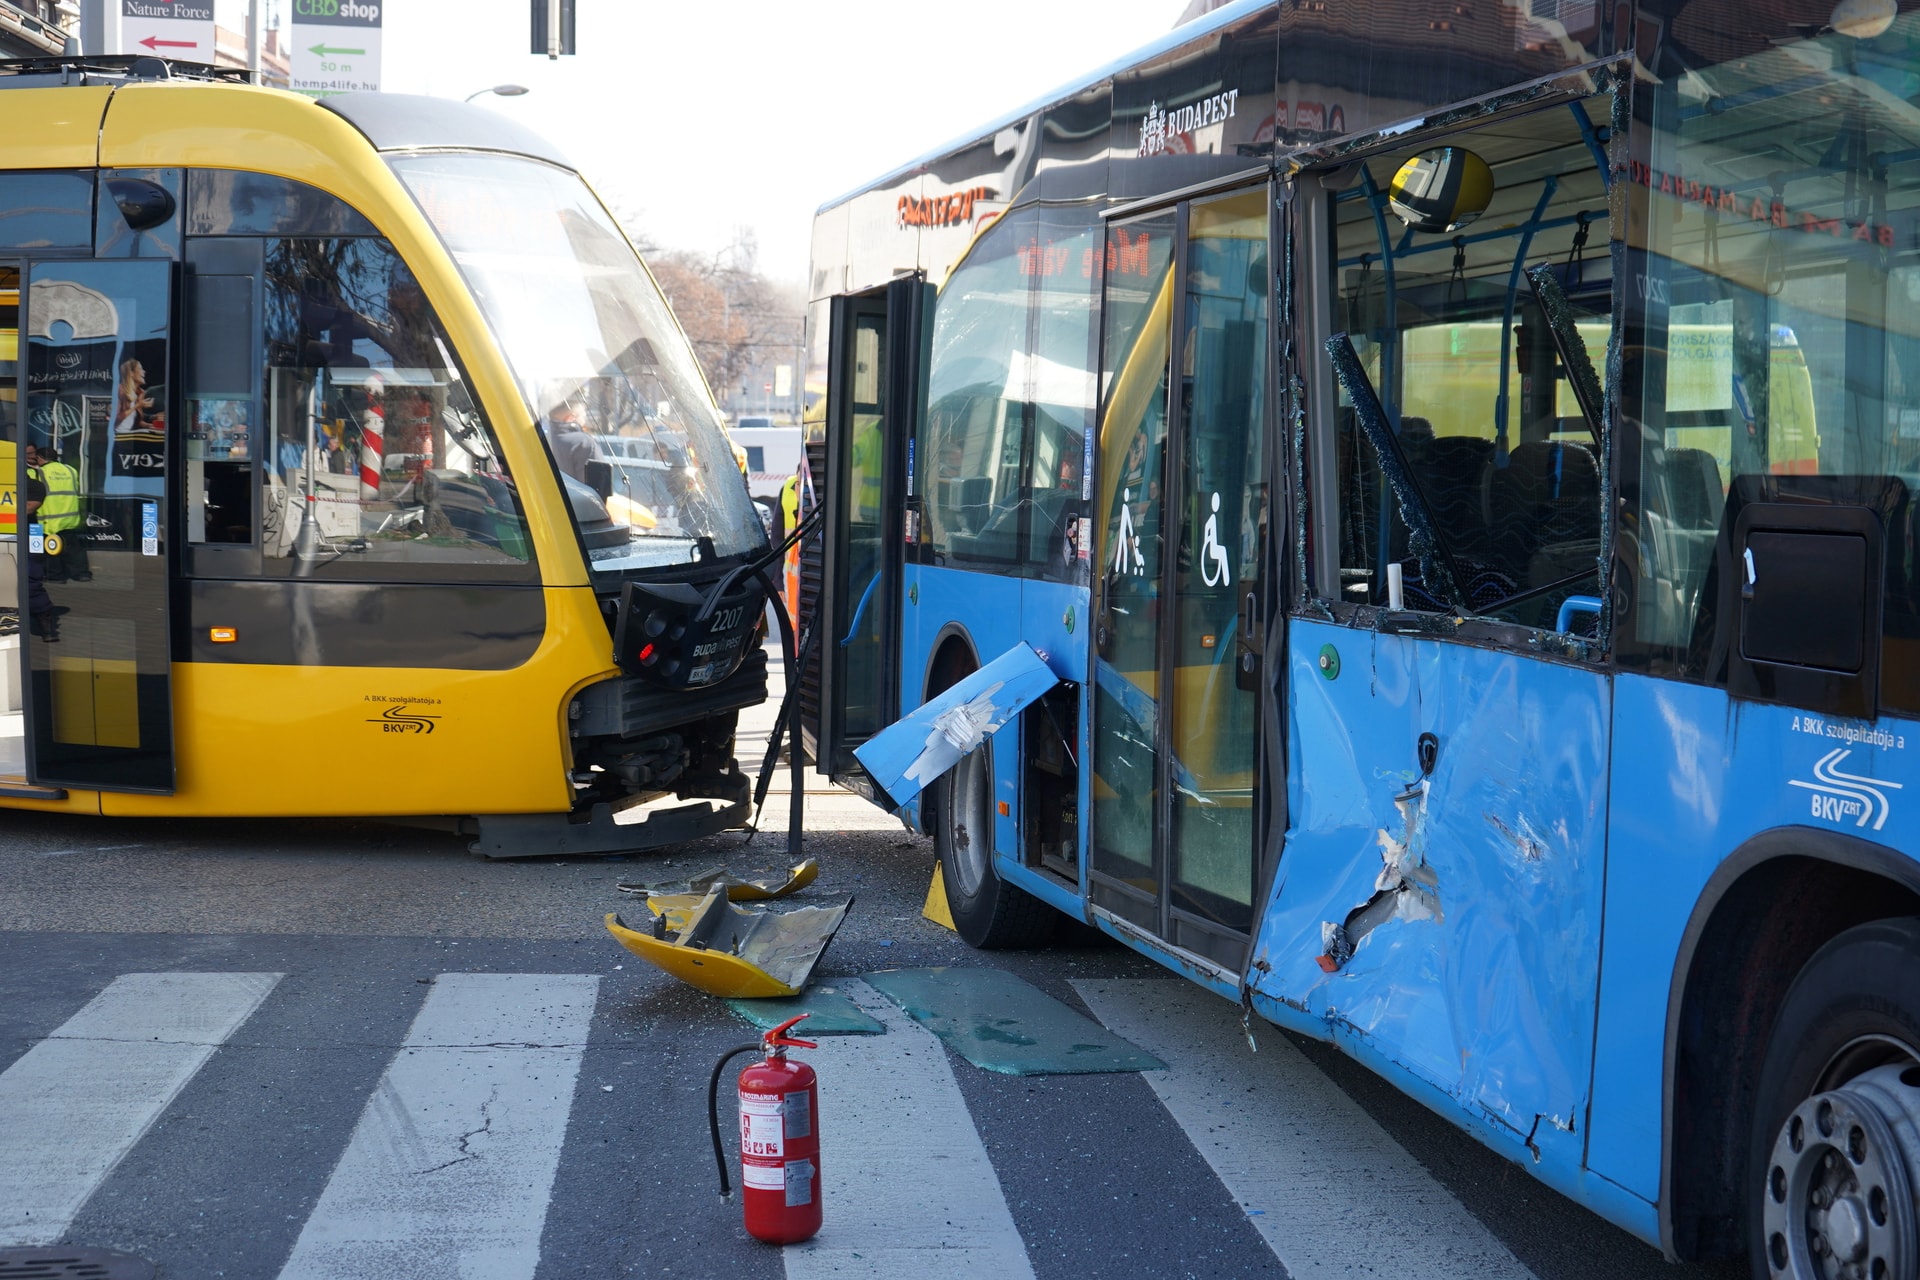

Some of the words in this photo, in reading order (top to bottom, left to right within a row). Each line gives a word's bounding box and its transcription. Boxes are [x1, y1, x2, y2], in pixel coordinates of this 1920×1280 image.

[127, 1, 170, 17] Nature
[173, 4, 210, 19] Force
[296, 0, 338, 16] CBD
[340, 0, 379, 22] shop
[320, 62, 337, 72] 50
[340, 64, 352, 72] m
[293, 79, 378, 92] hemp4life.hu
[1167, 88, 1238, 138] BUDAPEST
[710, 606, 744, 632] 2207
[389, 696, 434, 705] szolgáltatója
[1791, 716, 1800, 732] A
[1803, 717, 1824, 736] BKK
[1896, 735, 1905, 749] a
